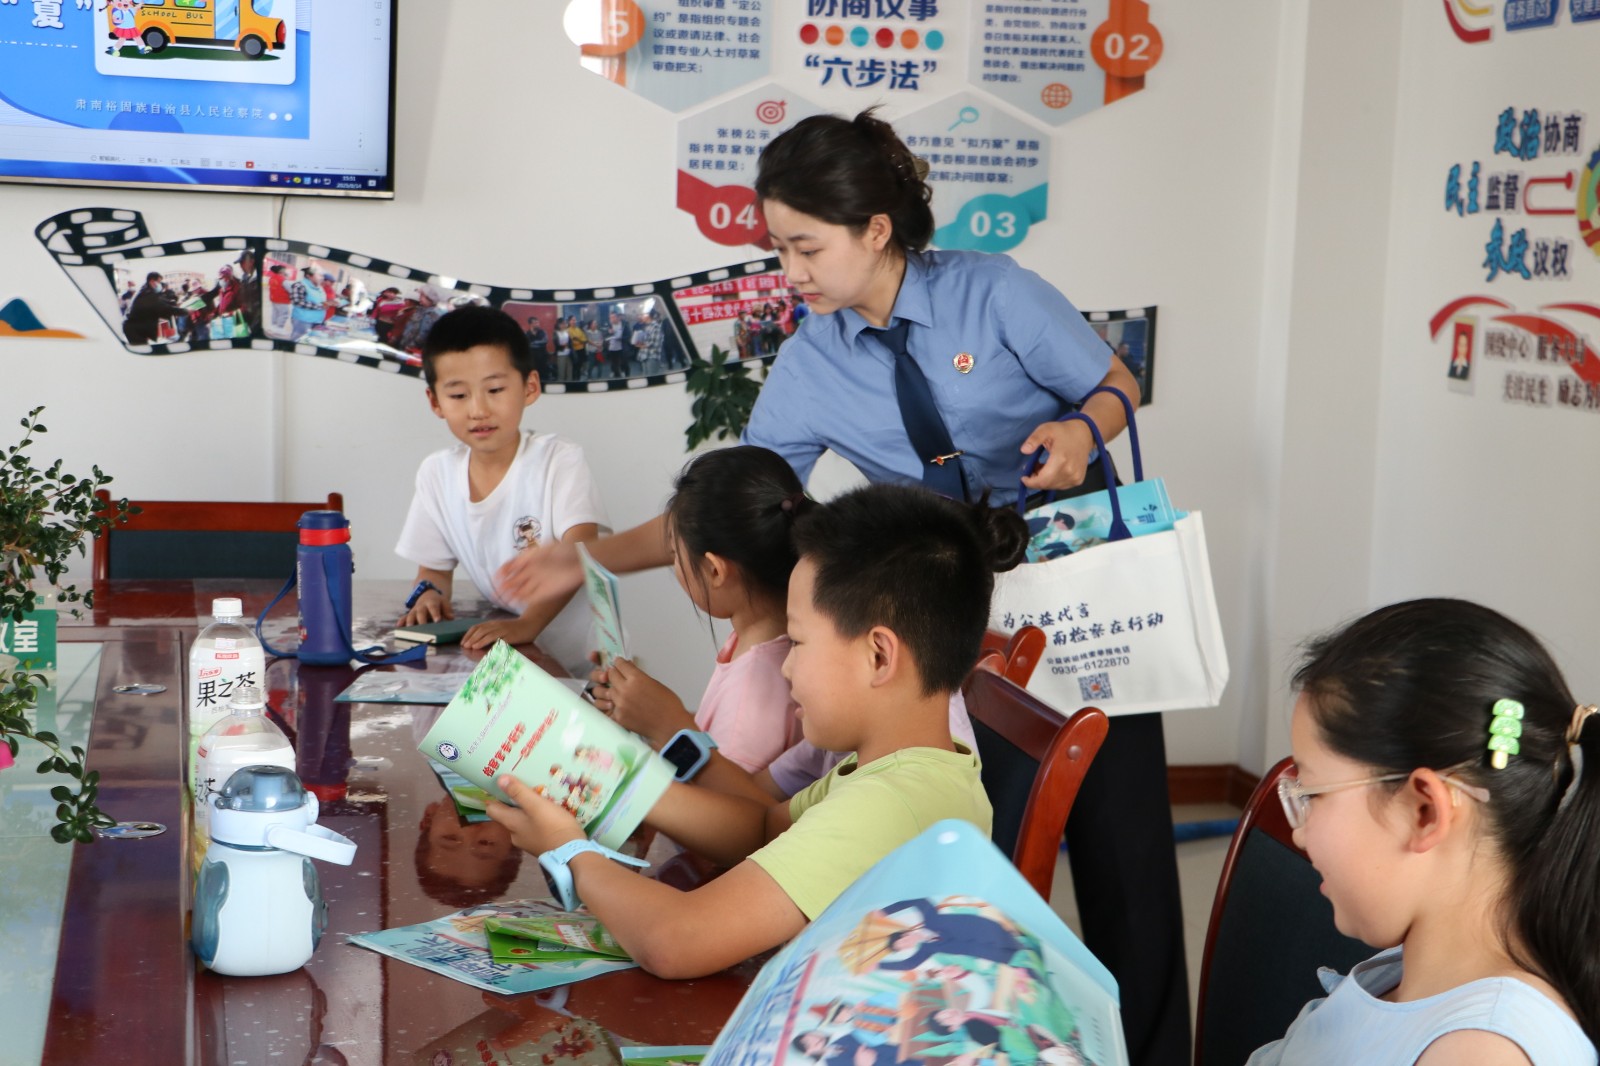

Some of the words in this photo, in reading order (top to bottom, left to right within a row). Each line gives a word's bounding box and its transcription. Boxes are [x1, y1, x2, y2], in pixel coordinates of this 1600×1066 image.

[652, 44, 760, 59] 管理专业人士对草案
[1104, 33, 1150, 60] 02
[75, 99, 263, 119] 肃南裕固族自治县人民检察院
[709, 202, 759, 230] 04
[970, 211, 1016, 238] 03
[1051, 656, 1130, 676] 0936-6122870
